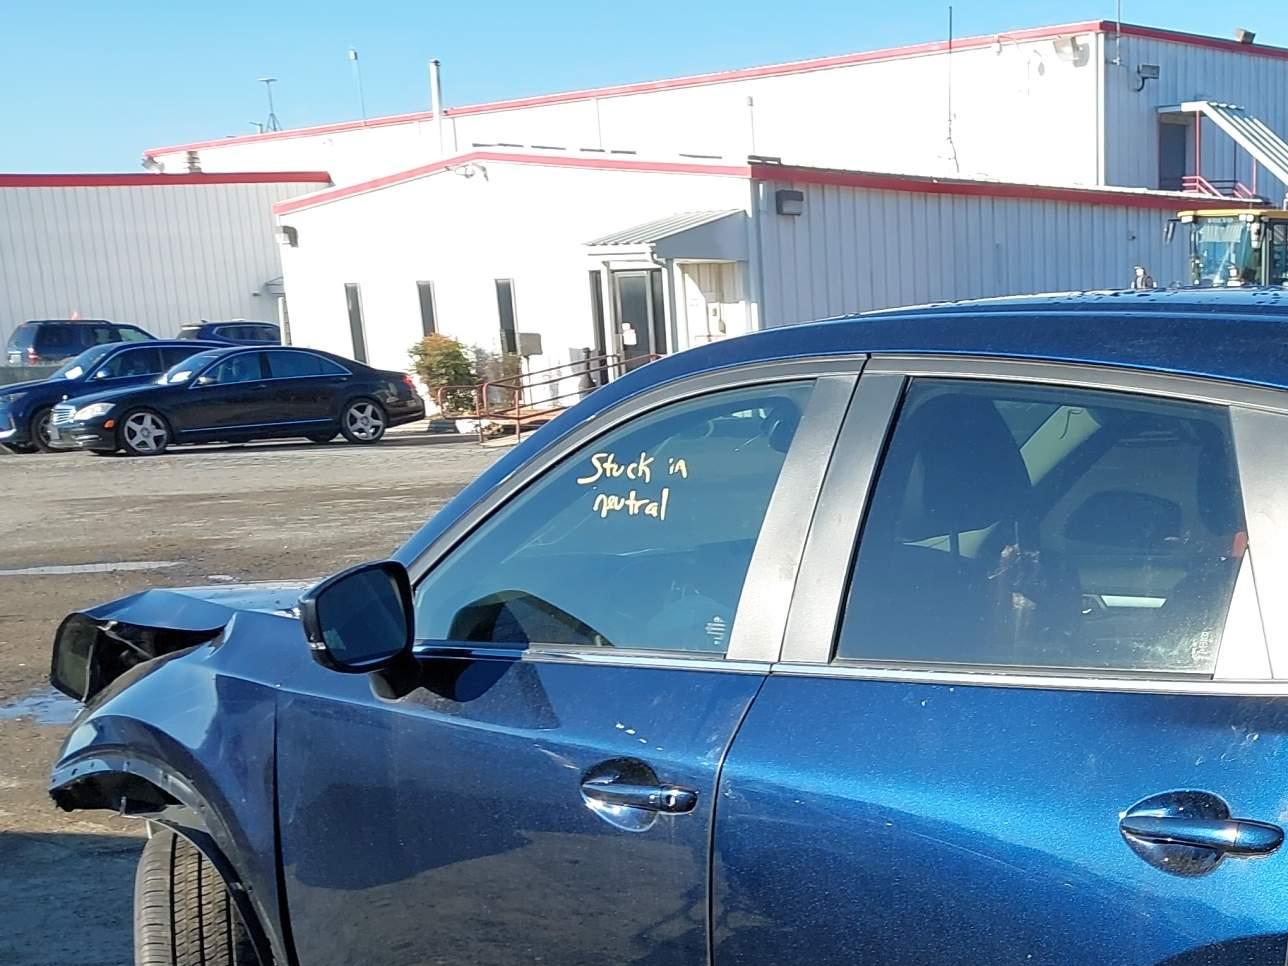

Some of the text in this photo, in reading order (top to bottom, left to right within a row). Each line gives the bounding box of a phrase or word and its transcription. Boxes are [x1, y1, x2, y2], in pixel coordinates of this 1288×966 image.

[577, 452, 688, 484] Stuck in
[592, 488, 669, 521] neutral
